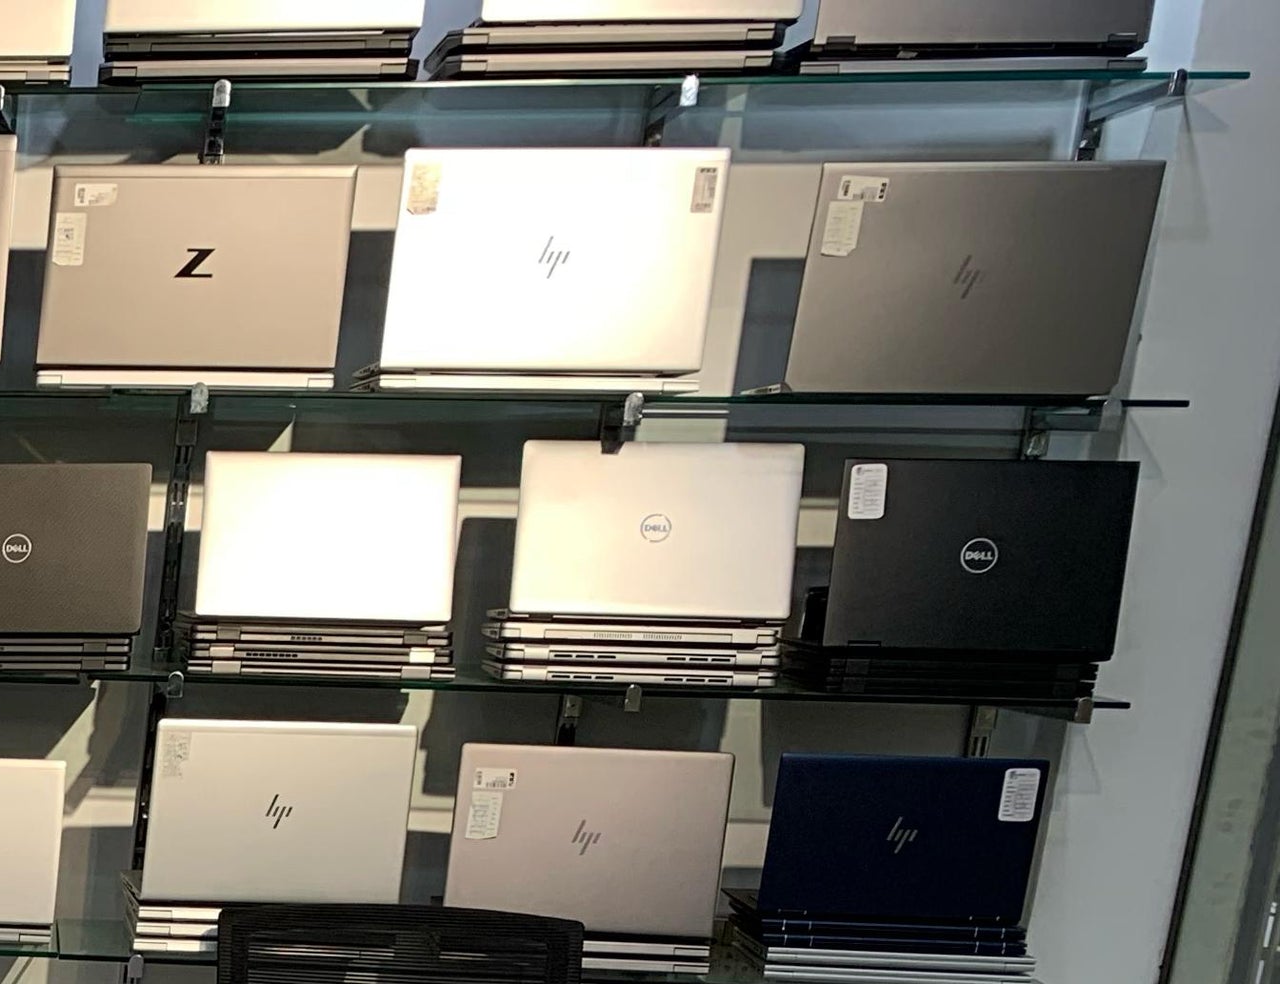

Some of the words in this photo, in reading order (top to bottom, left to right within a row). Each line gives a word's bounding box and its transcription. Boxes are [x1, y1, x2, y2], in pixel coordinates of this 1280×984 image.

[174, 248, 216, 278] Z
[538, 236, 571, 279] hp
[6, 543, 29, 553] DELL
[965, 551, 993, 561] DELL
[265, 794, 293, 829] hp
[571, 819, 602, 855] hp
[886, 816, 918, 854] hp
